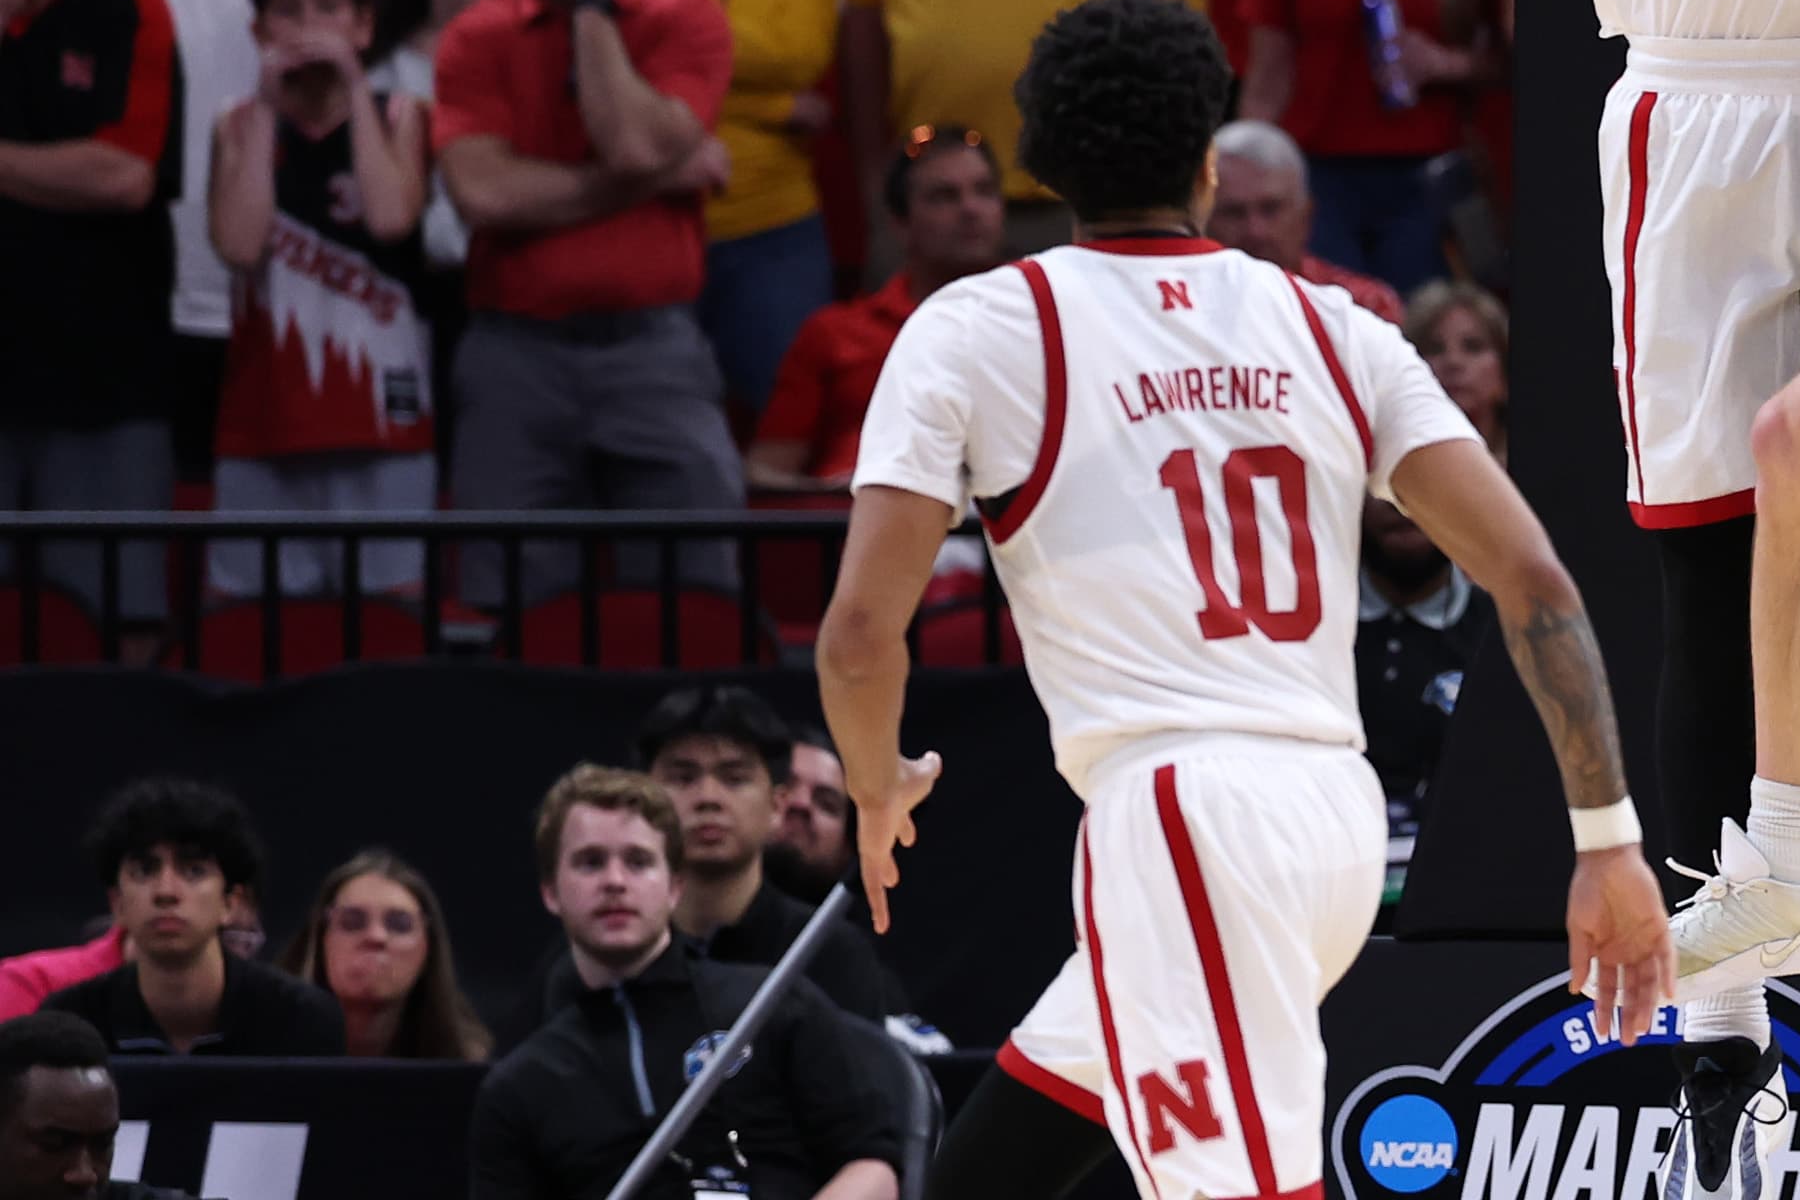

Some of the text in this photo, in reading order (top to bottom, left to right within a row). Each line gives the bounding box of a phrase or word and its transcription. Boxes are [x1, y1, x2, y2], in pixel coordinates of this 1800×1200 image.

[1157, 280, 1193, 311] N
[1114, 367, 1293, 423] LAWRENCE
[1160, 445, 1322, 642] 10
[1137, 1059, 1224, 1156] N
[1369, 1141, 1453, 1169] NCAA
